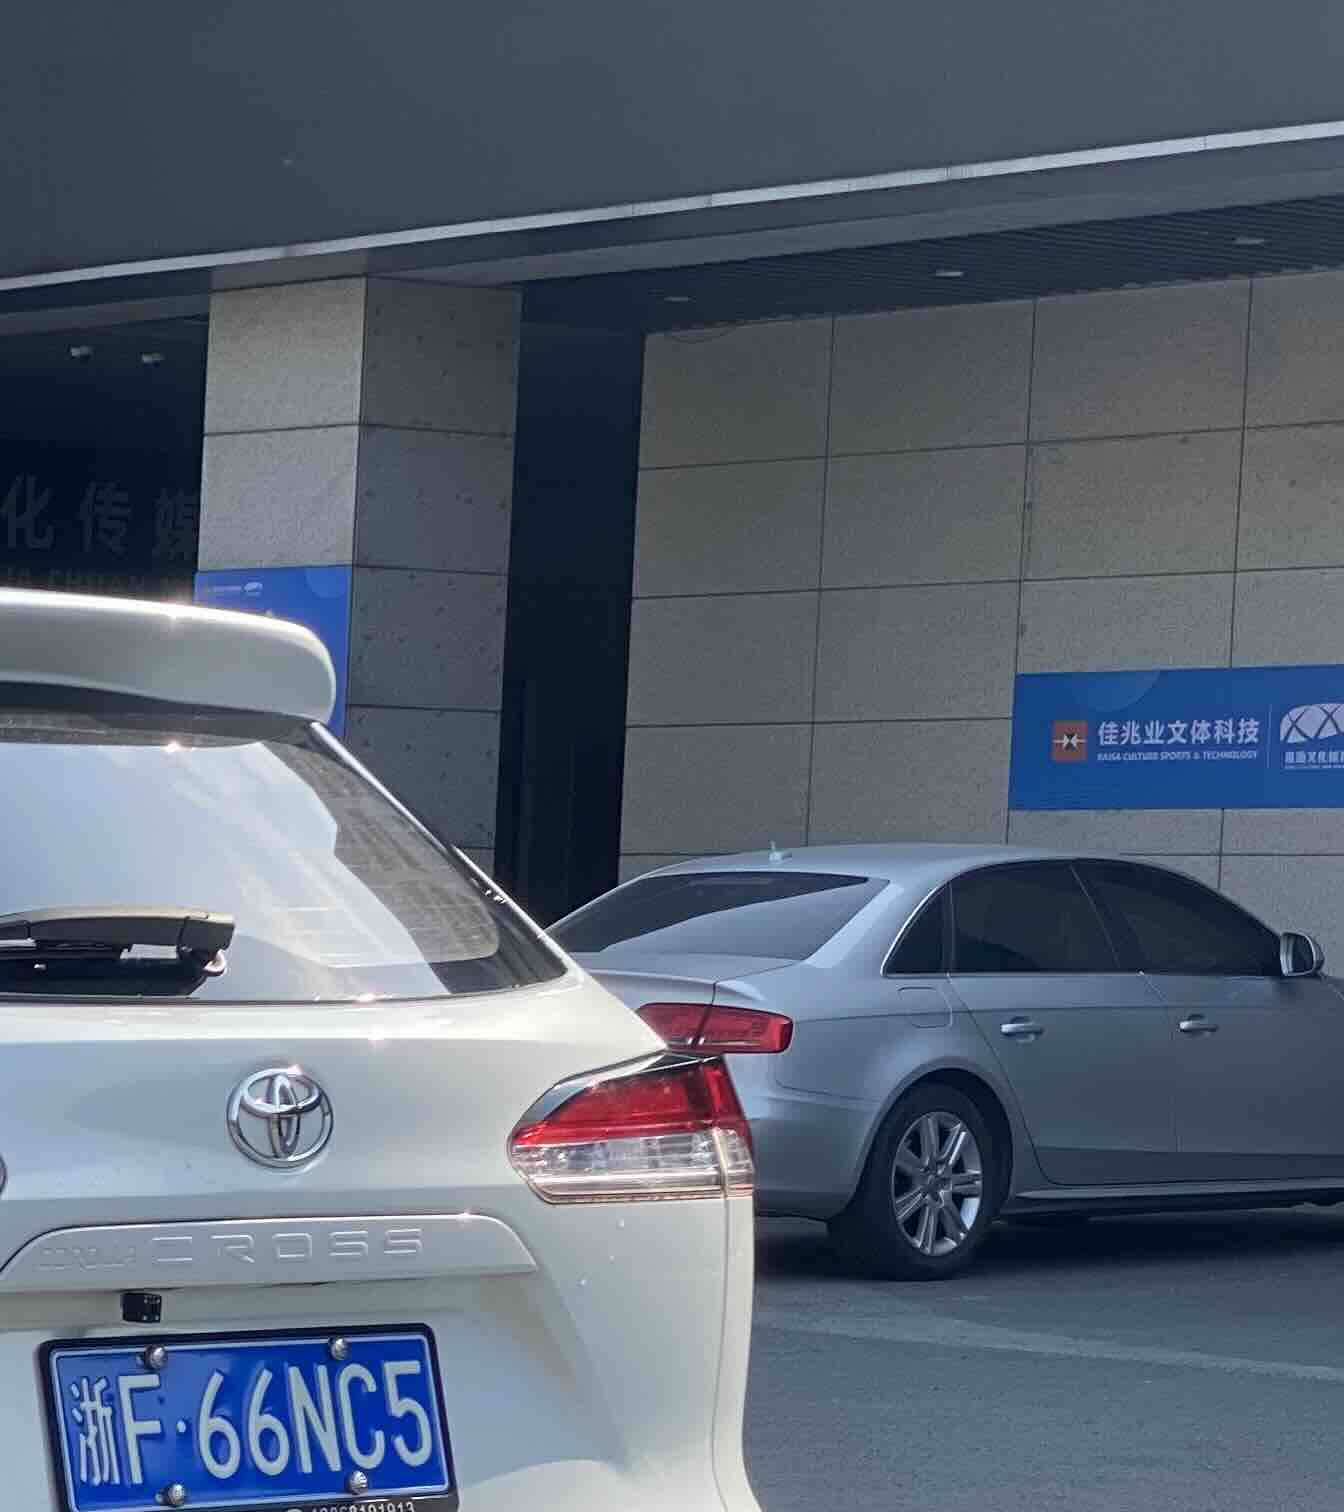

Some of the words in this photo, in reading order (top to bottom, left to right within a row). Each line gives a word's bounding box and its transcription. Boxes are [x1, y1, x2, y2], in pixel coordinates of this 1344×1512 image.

[1097, 718, 1260, 746] 佳兆业文体科技
[1160, 751, 1191, 760] SPORTS
[151, 1228, 424, 1264] CROSS
